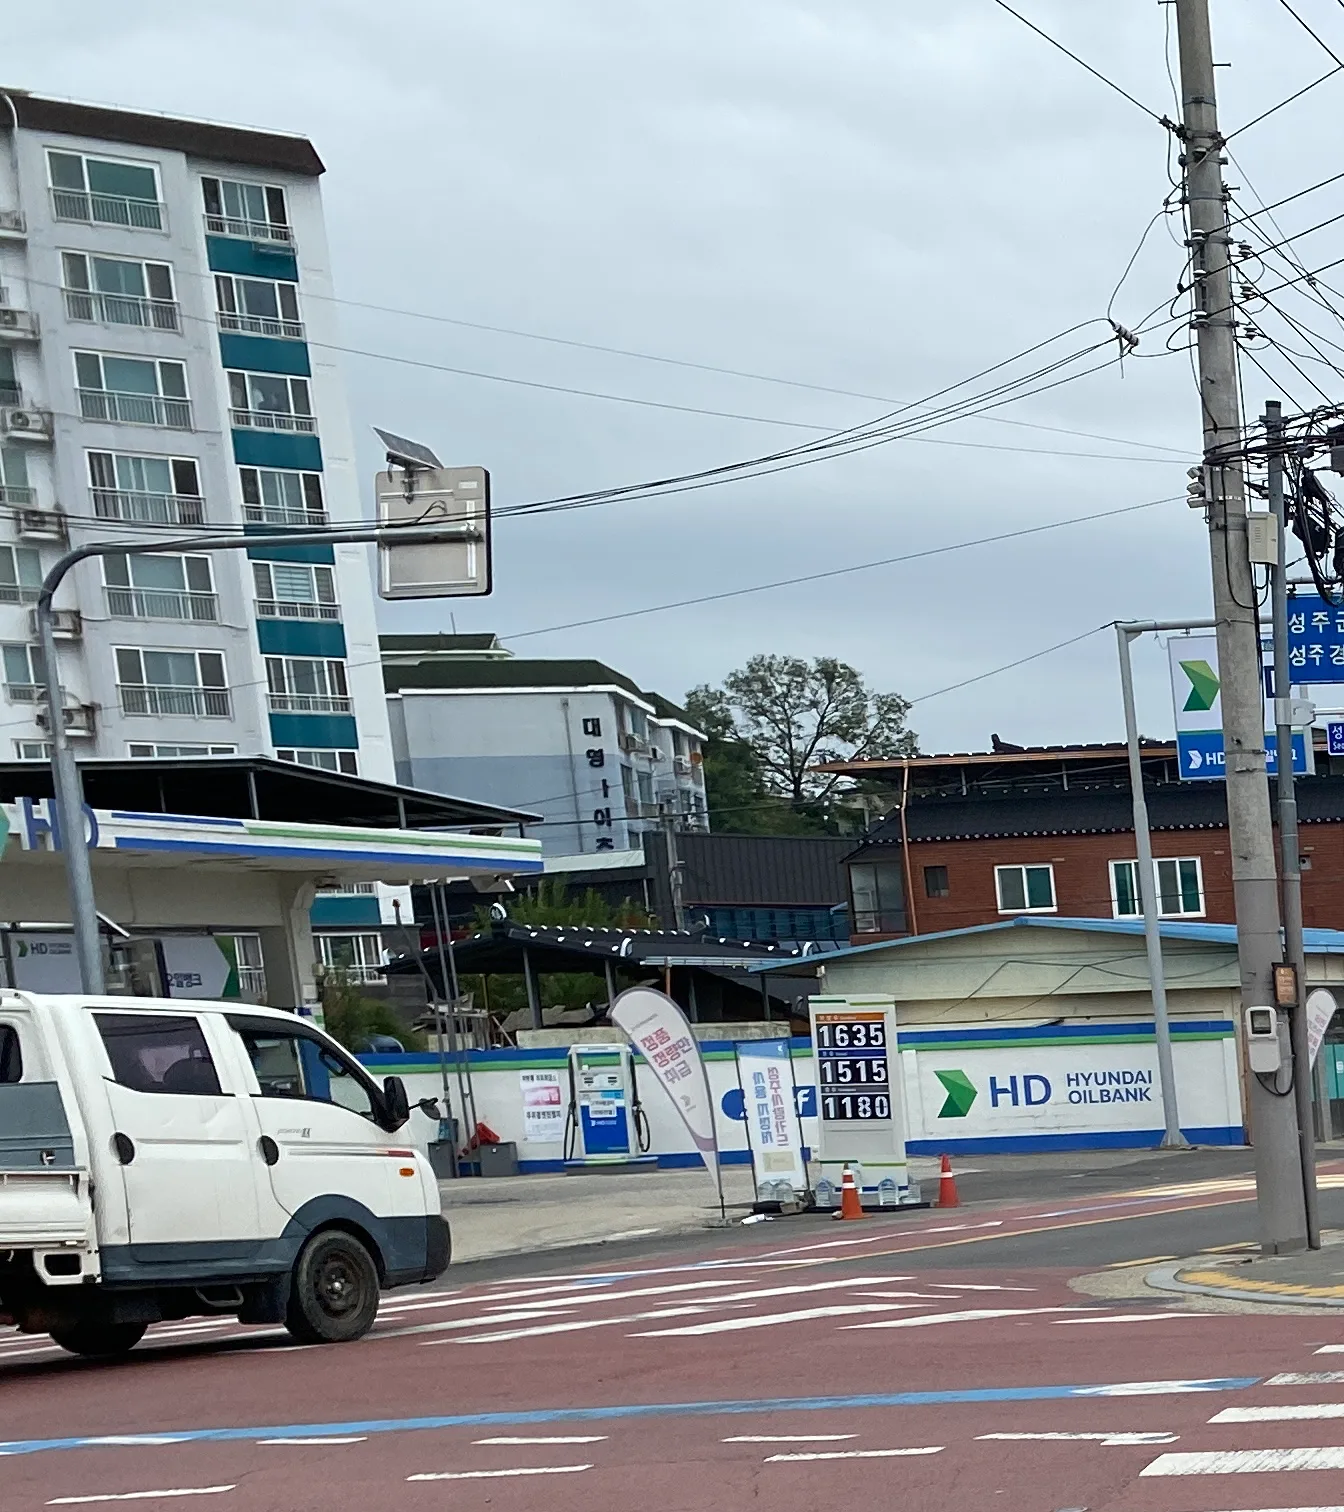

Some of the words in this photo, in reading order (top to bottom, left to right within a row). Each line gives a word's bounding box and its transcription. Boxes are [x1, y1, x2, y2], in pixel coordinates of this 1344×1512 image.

[640, 1027, 671, 1052] 정품
[819, 1024, 883, 1047] 1635
[653, 1036, 691, 1068] 정량만
[822, 1060, 886, 1083] 1515
[1066, 1070, 1152, 1087] HYUNDAI
[989, 1074, 1052, 1107] HD
[1068, 1087, 1152, 1104] OILBANK
[824, 1096, 889, 1118] 1180
